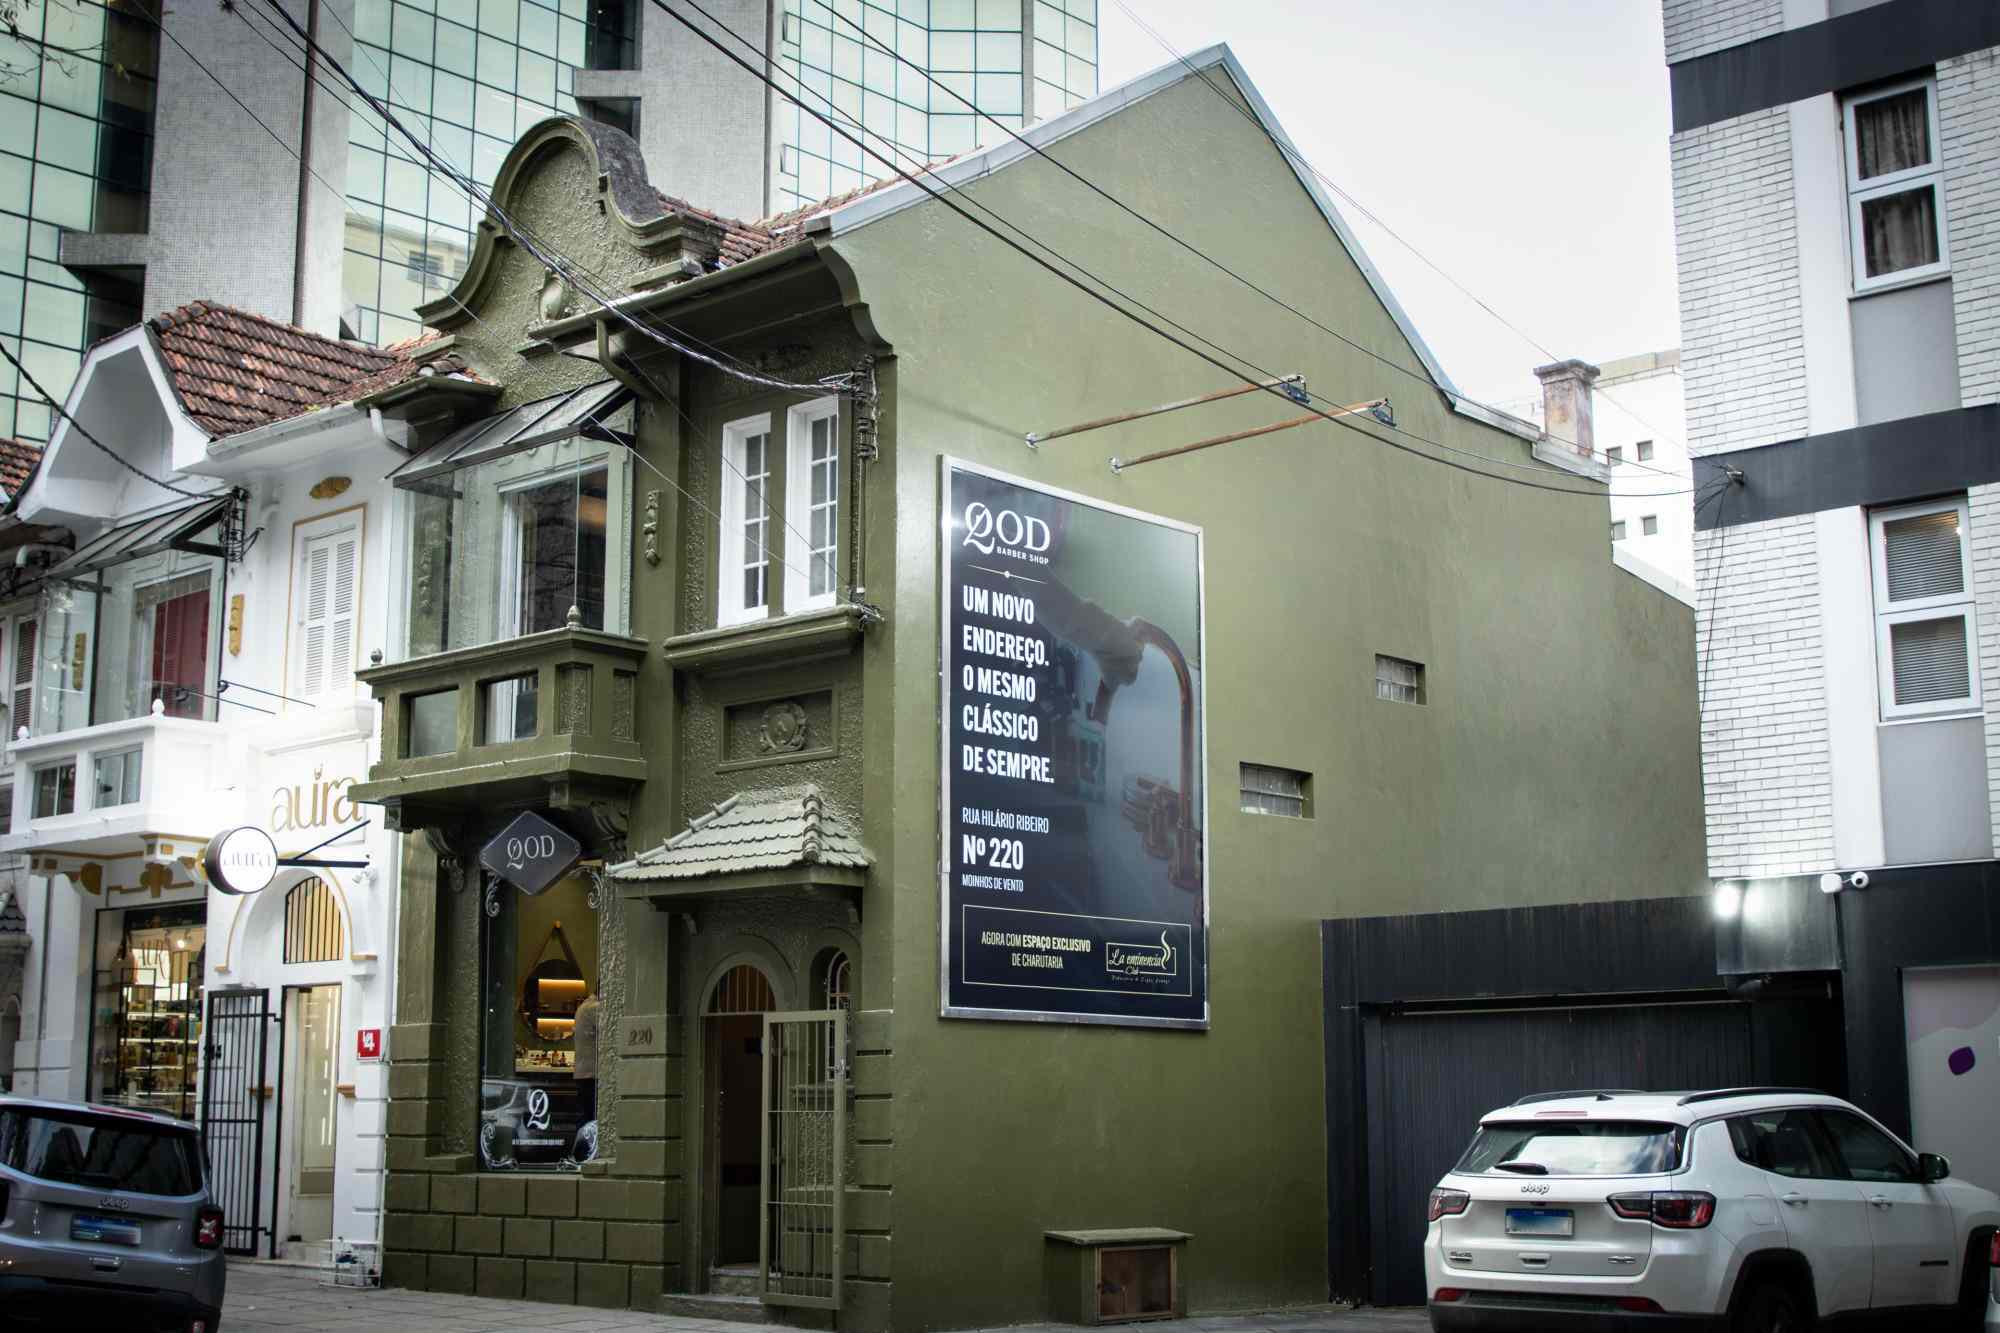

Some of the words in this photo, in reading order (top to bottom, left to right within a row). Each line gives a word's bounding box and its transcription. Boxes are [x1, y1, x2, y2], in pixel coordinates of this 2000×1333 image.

[963, 502, 1050, 554] QOD
[996, 546, 1027, 560] BARBER
[1029, 553, 1049, 565] SHOP
[963, 584, 989, 615] UM
[992, 591, 1034, 624] NOVO
[963, 624, 1050, 668] ENDEREÇO.
[963, 664, 974, 691] O
[977, 667, 1036, 702] MESMO
[963, 703, 1039, 742] CLÁSSICO
[963, 744, 984, 773] DE
[986, 748, 1055, 783] SEMPRE.
[272, 764, 362, 832] aura
[962, 806, 981, 825] RUA
[981, 808, 1015, 830] HILÁRIO
[1016, 813, 1049, 834] RIBEIRO
[506, 835, 555, 870] QOD
[989, 837, 1024, 870] 220
[962, 873, 993, 889] MOINHOS
[993, 877, 1003, 890] DE
[1002, 879, 1024, 893] VENTO
[981, 931, 1005, 946] AGORA
[1006, 933, 1022, 947] COM
[1022, 935, 1051, 952] ESPAÇO
[1052, 937, 1091, 953] EXCLUSIVO
[1108, 948, 1125, 967] La
[1011, 953, 1022, 967] DE
[1022, 953, 1063, 969] CHARUTARIA
[629, 1027, 653, 1046] 220
